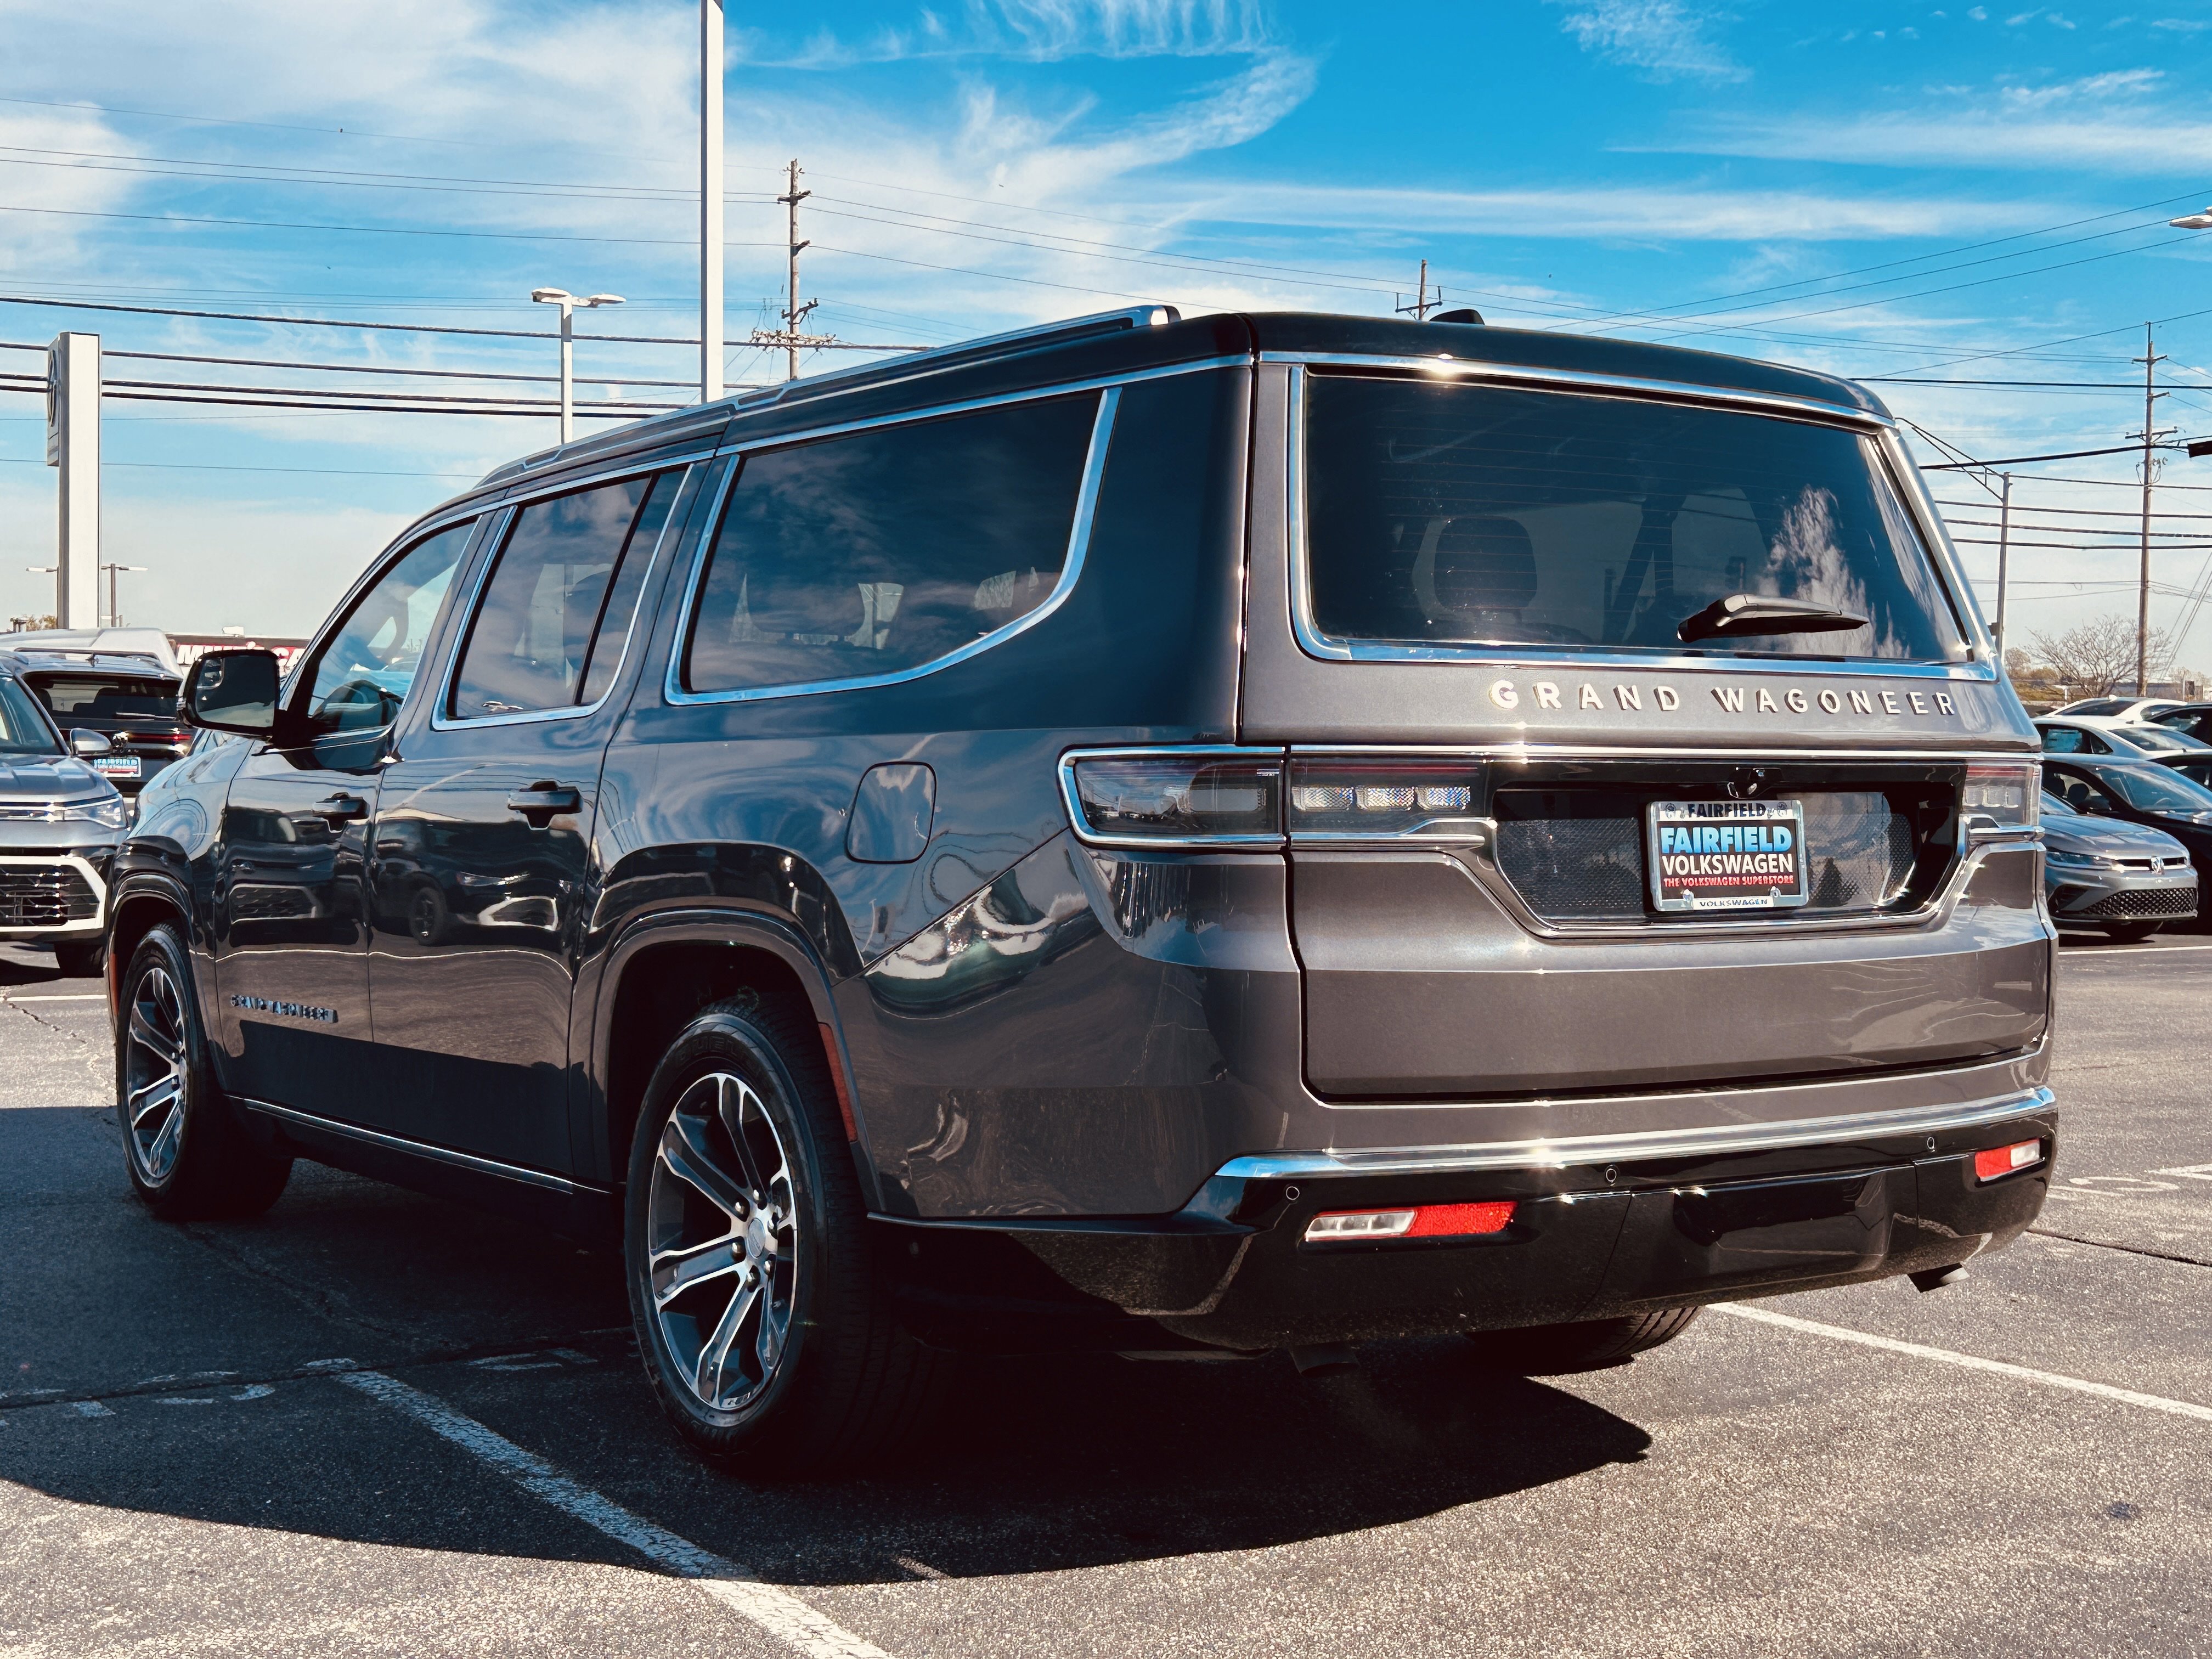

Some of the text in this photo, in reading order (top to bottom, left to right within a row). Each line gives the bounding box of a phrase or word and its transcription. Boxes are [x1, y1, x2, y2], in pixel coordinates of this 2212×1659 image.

[1488, 679, 1955, 715] GRAND WAGONEER
[1688, 803, 1766, 817] FAIRFIELD
[1661, 826, 1792, 853] FAIRFIELD
[1662, 853, 1793, 876] VOLKSWAGEN
[1663, 875, 1794, 887] THE VOLKSWAGEN SUPERSTORE
[1700, 899, 1768, 907] VOLKSWAGEN
